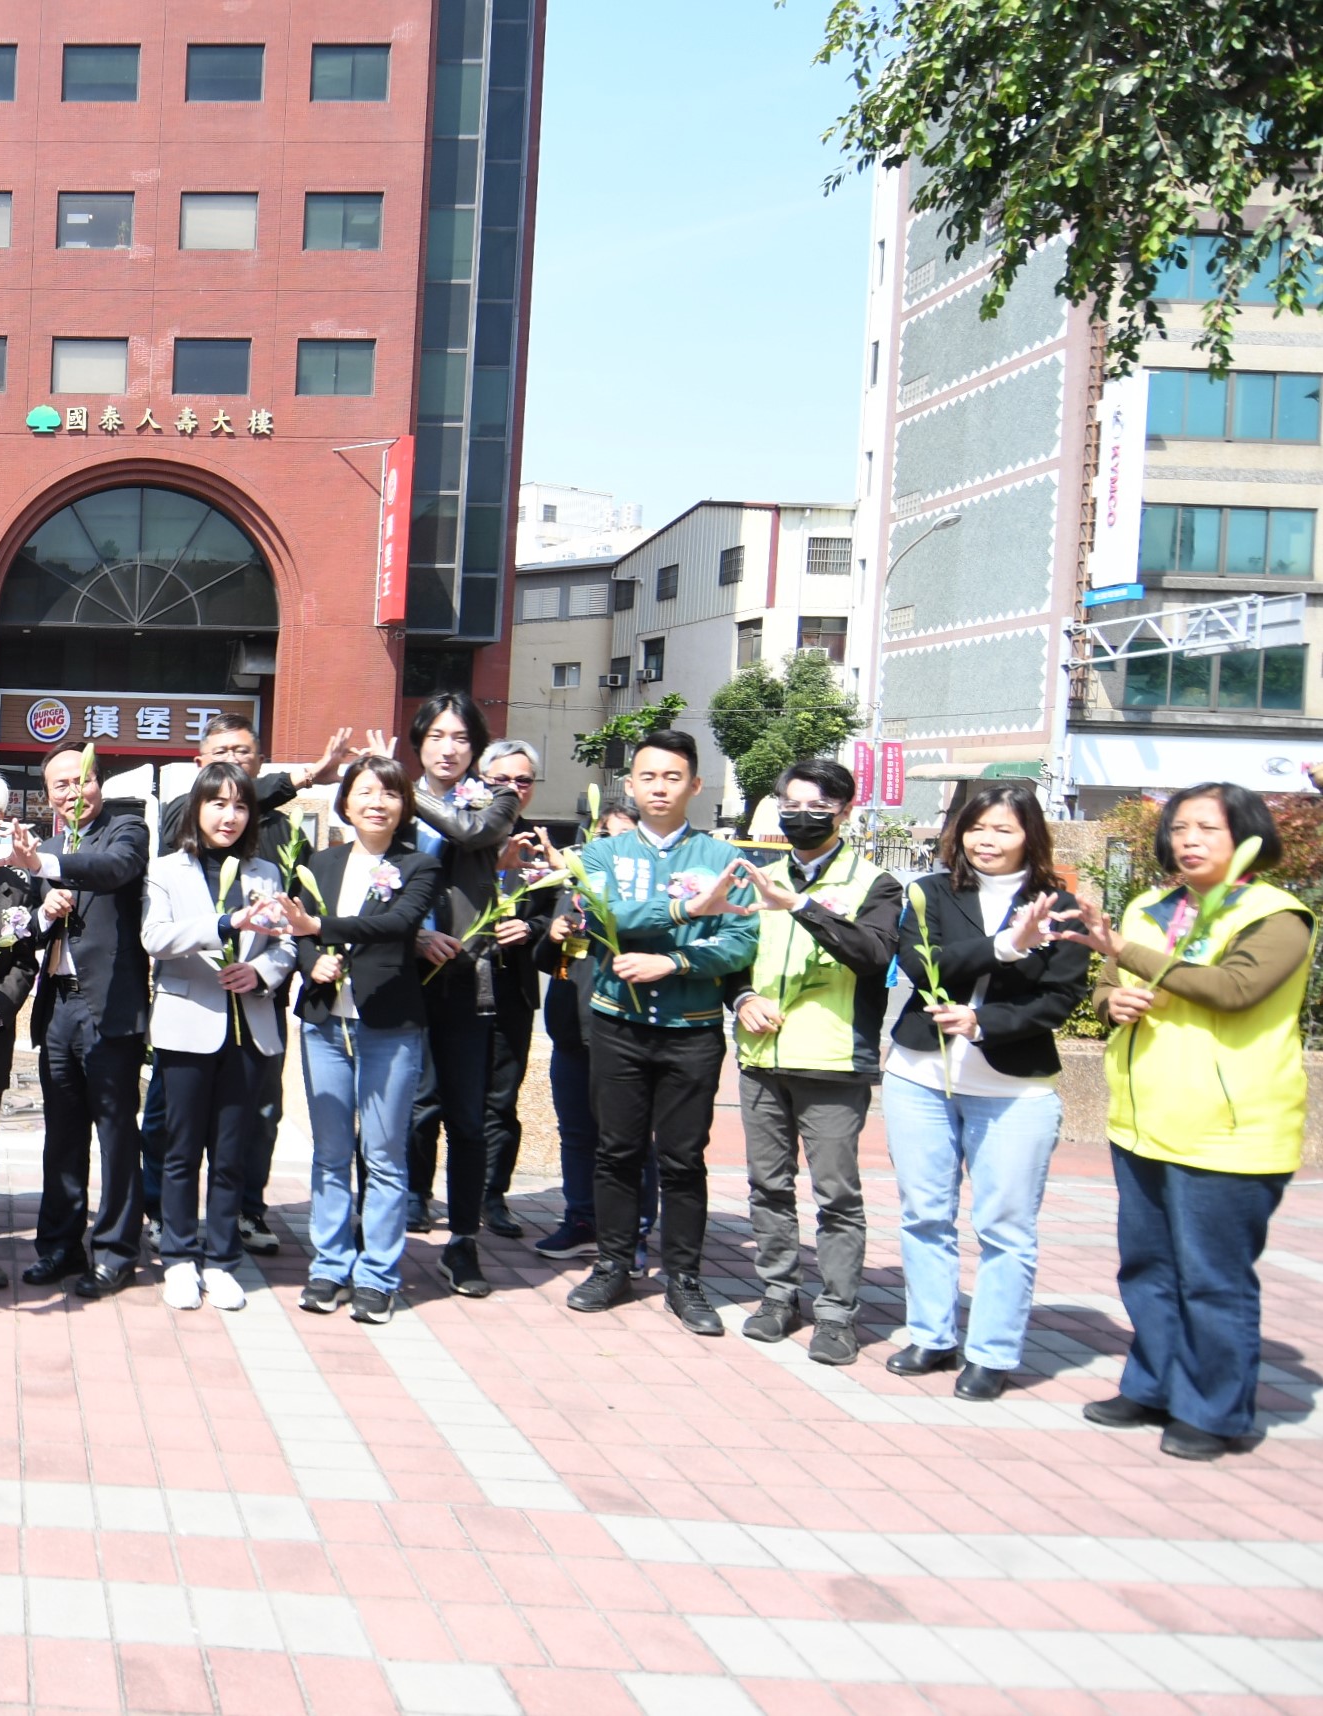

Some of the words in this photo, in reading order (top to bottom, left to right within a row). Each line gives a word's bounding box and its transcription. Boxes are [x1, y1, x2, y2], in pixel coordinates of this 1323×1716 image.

[66, 405, 275, 436] 國泰人壽大樓
[1106, 444, 1121, 528] KYMCO
[34, 708, 64, 720] BURGER
[34, 715, 65, 730] KING
[83, 705, 222, 742] 漢堡王
